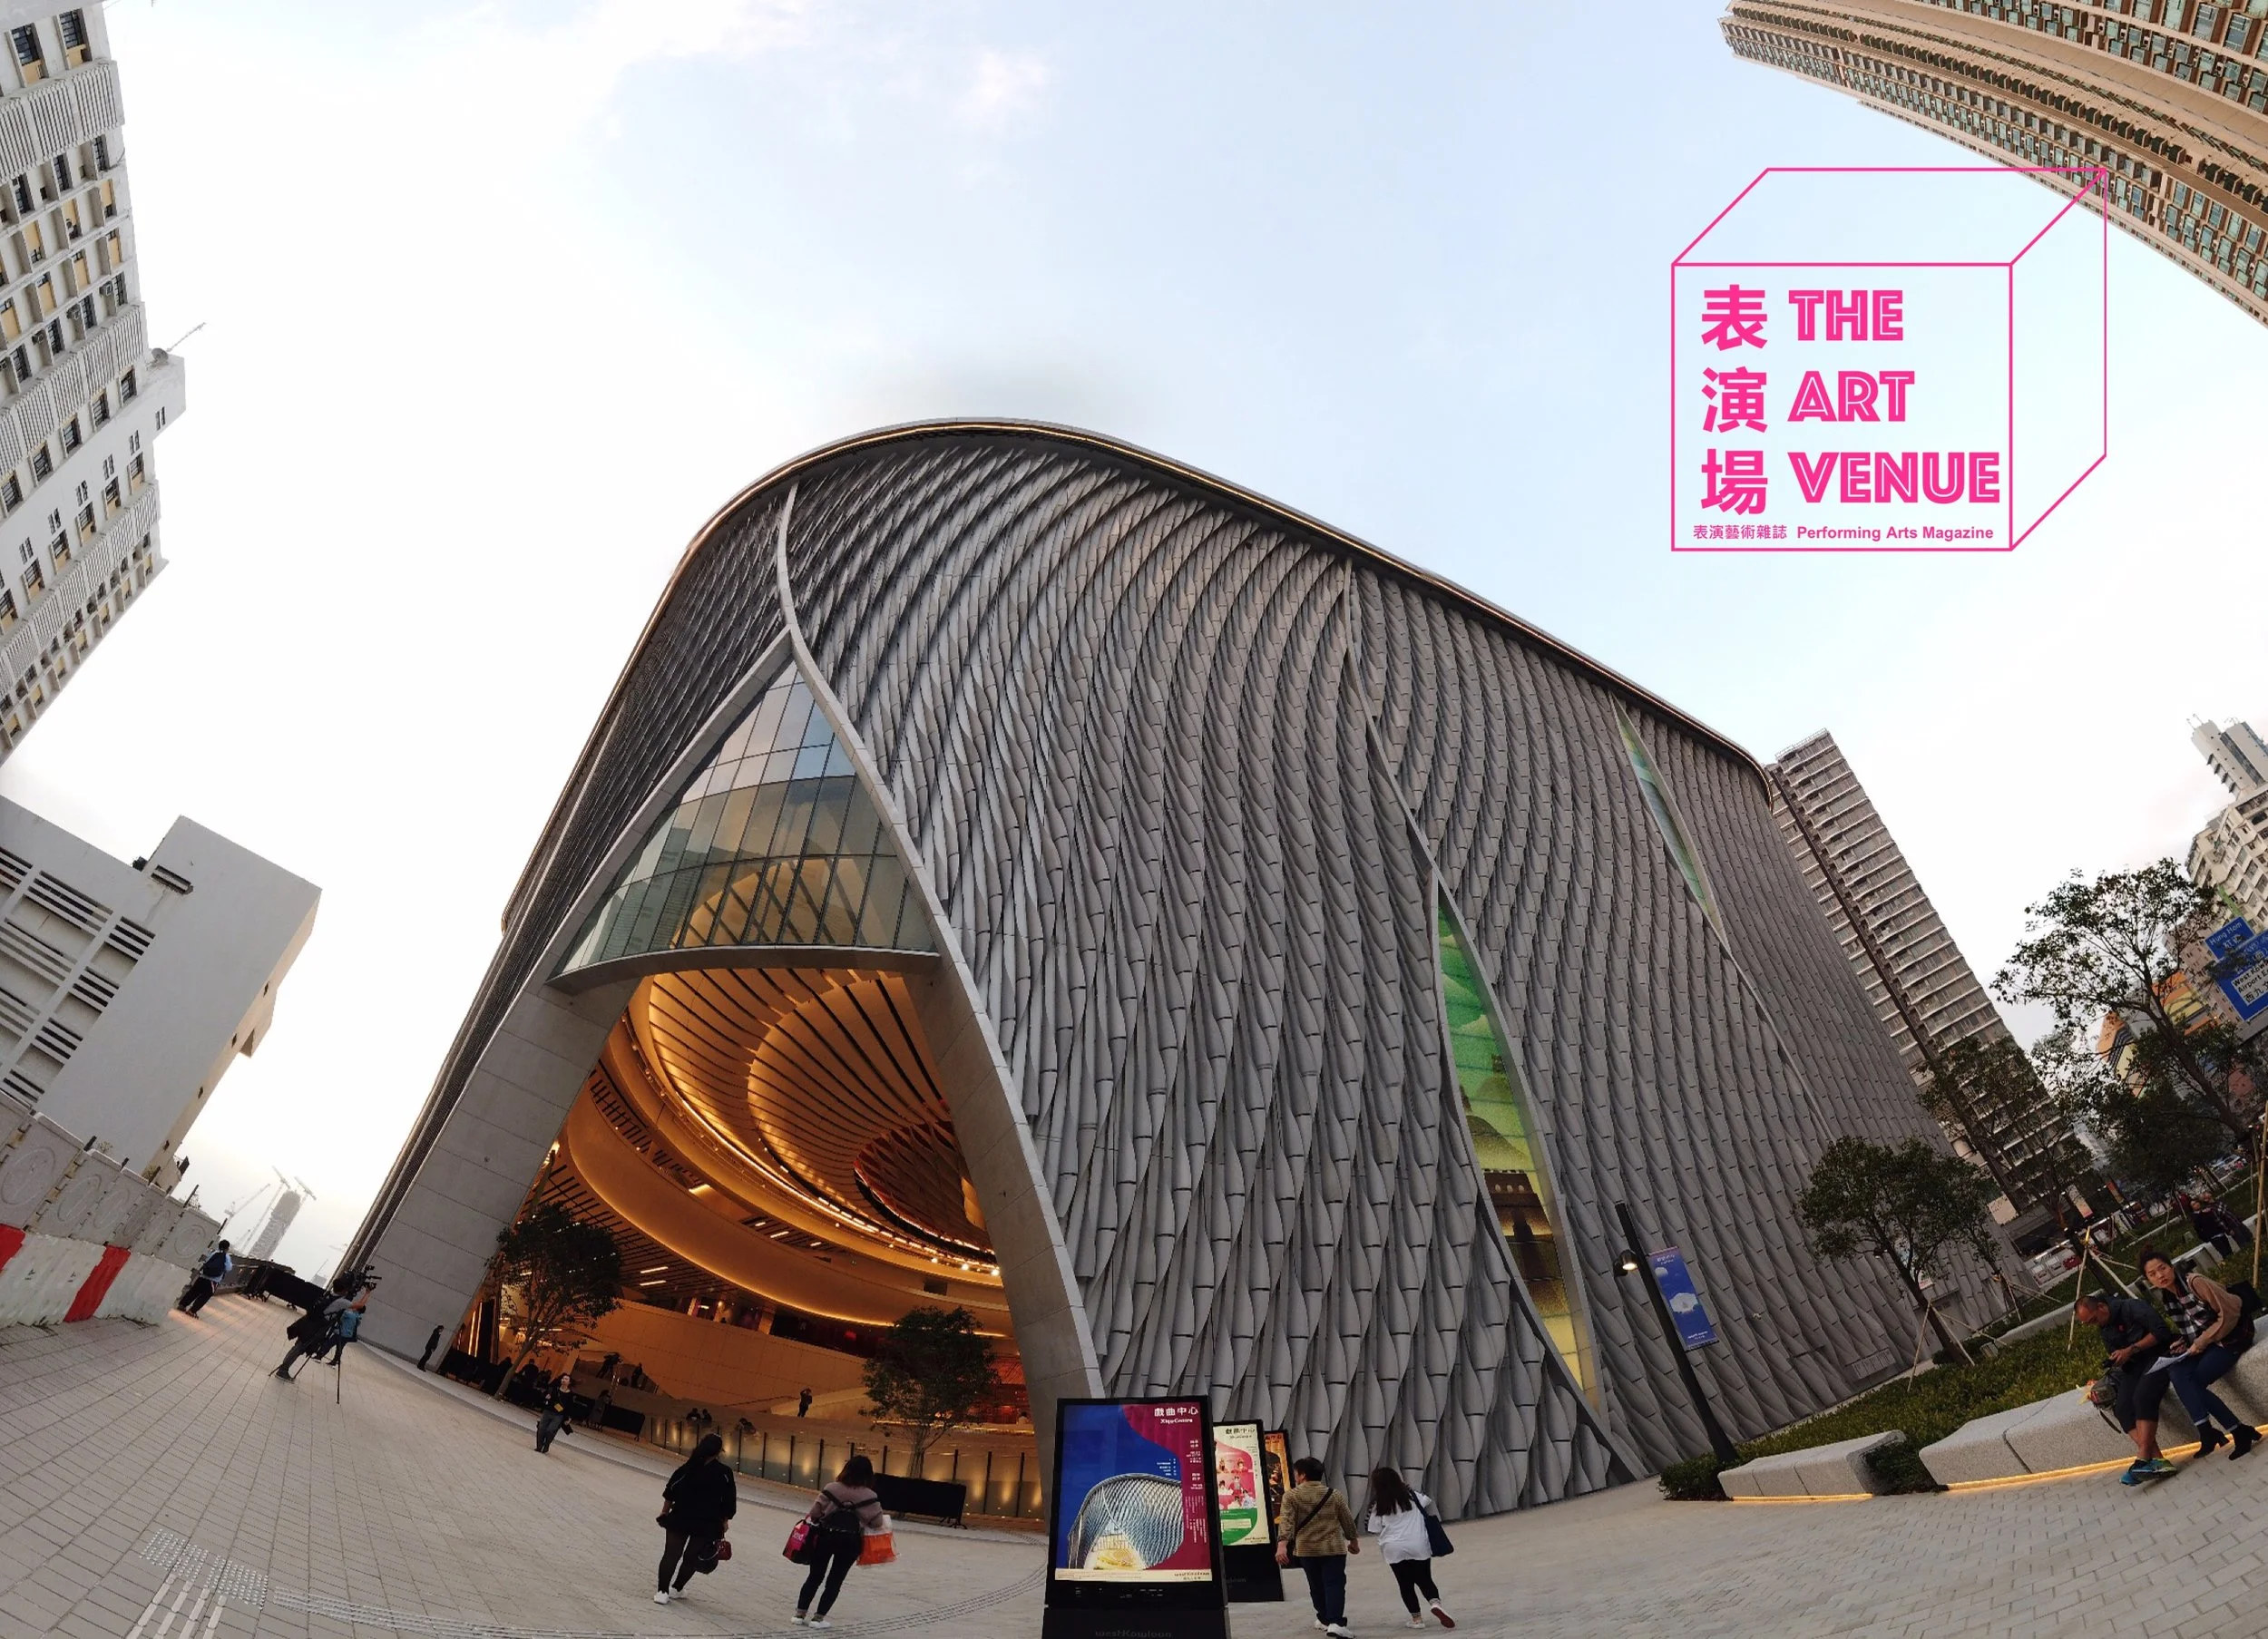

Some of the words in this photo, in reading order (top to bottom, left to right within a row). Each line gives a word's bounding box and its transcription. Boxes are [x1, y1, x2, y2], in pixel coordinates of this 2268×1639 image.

[2209, 932, 2228, 946] Hung
[2226, 922, 2243, 934] Hom
[2233, 972, 2251, 987] West
[2238, 975, 2262, 994] Airport
